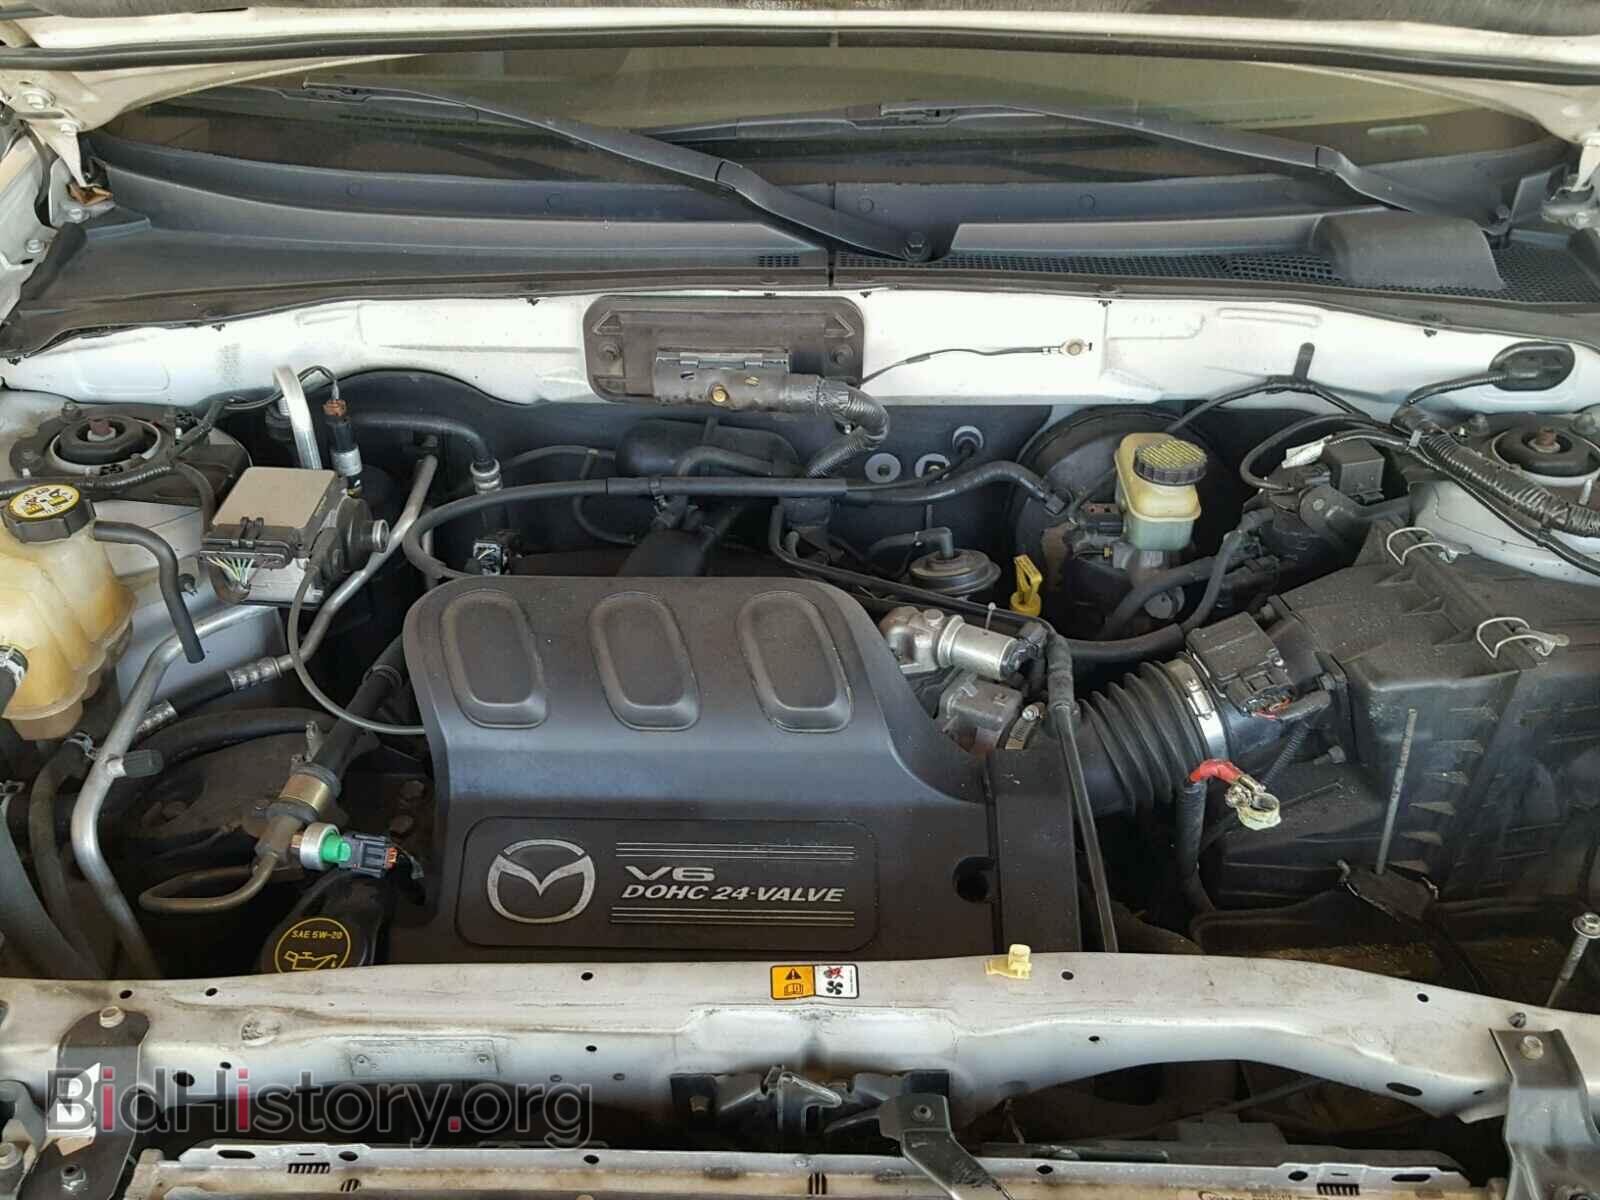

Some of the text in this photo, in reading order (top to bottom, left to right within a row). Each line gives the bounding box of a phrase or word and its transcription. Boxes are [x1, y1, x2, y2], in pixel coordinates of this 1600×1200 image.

[624, 865, 716, 882] V6
[620, 884, 846, 903] DOHC 24-VALVE
[291, 930, 344, 940] SAE 5W-20
